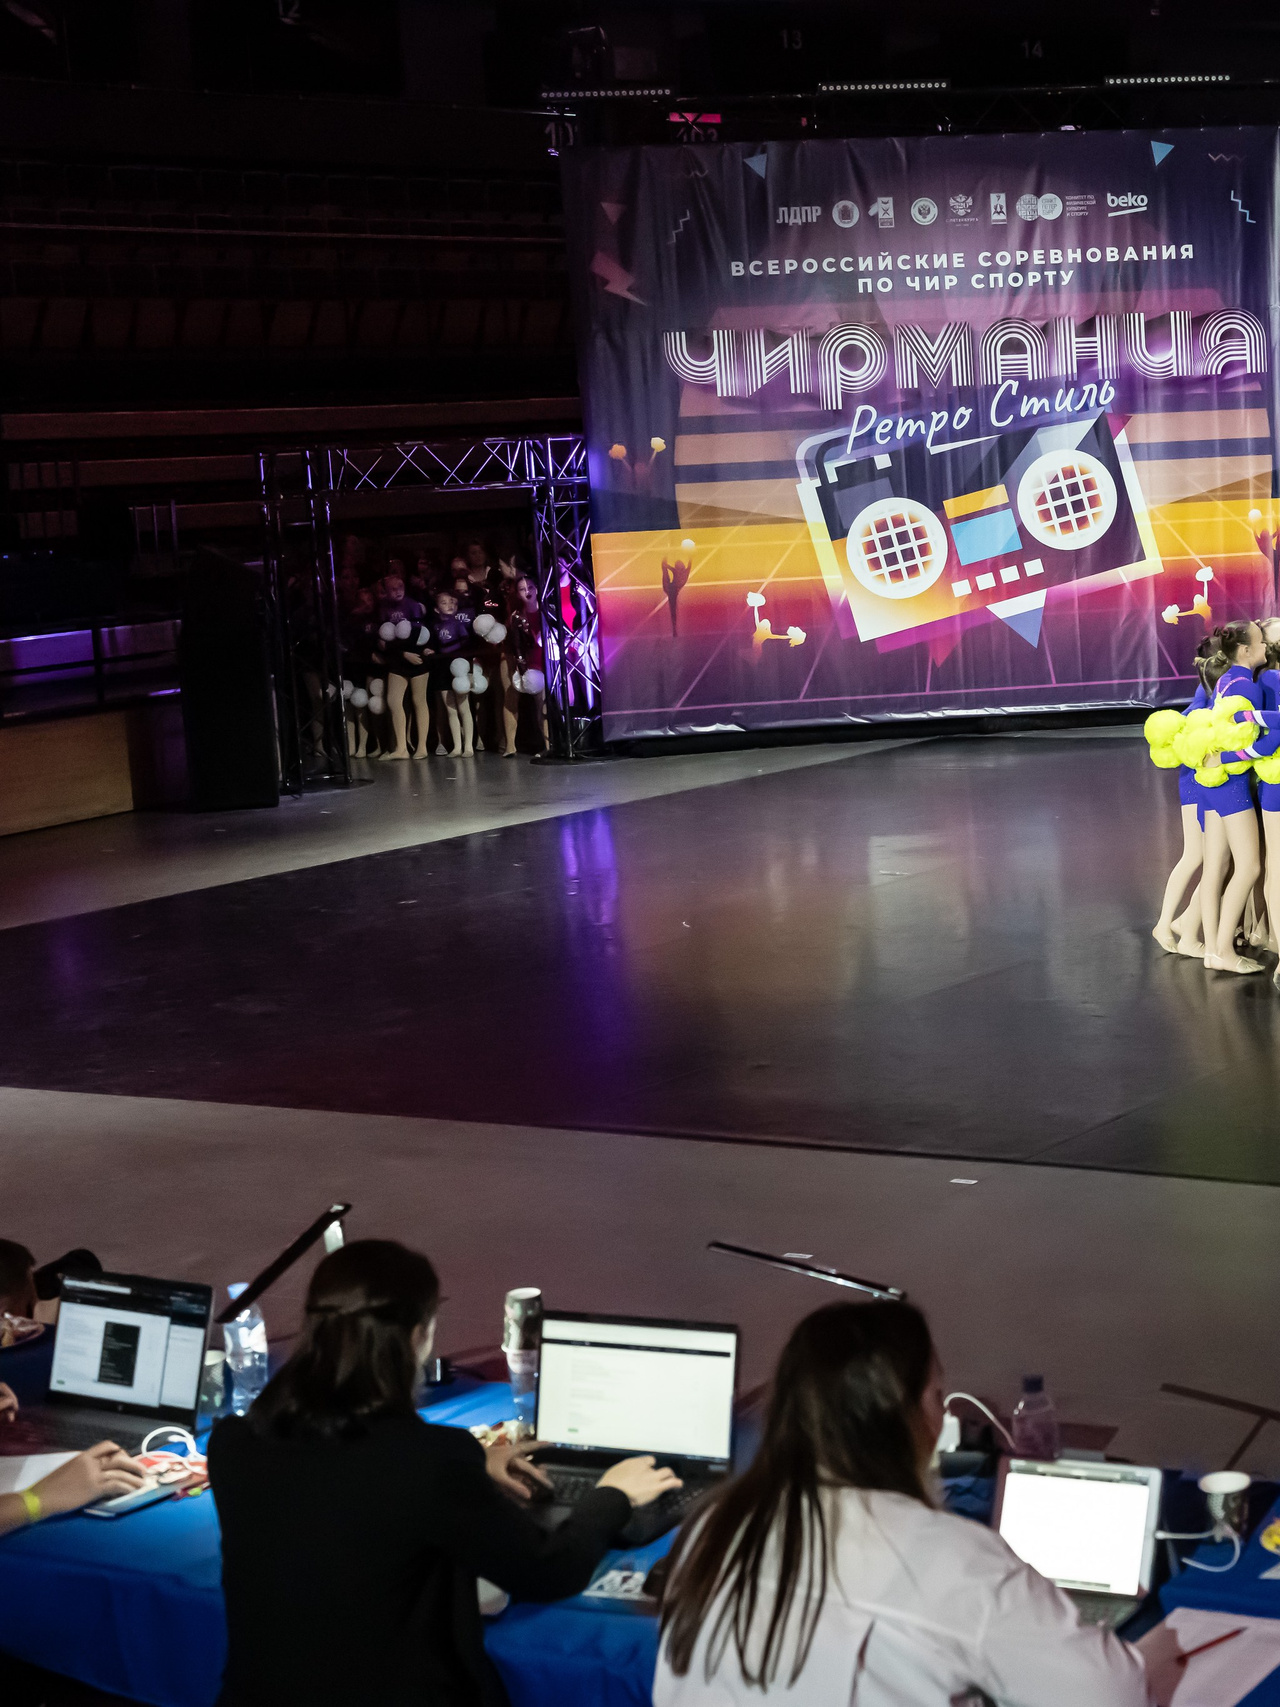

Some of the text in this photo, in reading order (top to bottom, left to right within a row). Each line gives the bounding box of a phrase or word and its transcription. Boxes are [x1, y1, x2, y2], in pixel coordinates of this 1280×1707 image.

[780, 29, 802, 50] 13
[1021, 39, 1044, 59] 14
[1107, 192, 1148, 208] beko
[776, 206, 821, 226] ЛДПР
[730, 244, 1195, 277] ВСЕРОССИЙСКИЕ СОРЕВНОВАНИЯ
[857, 268, 1075, 294] ПО ЧИР СПОРТУ
[847, 379, 1116, 455] Ретро Стиль
